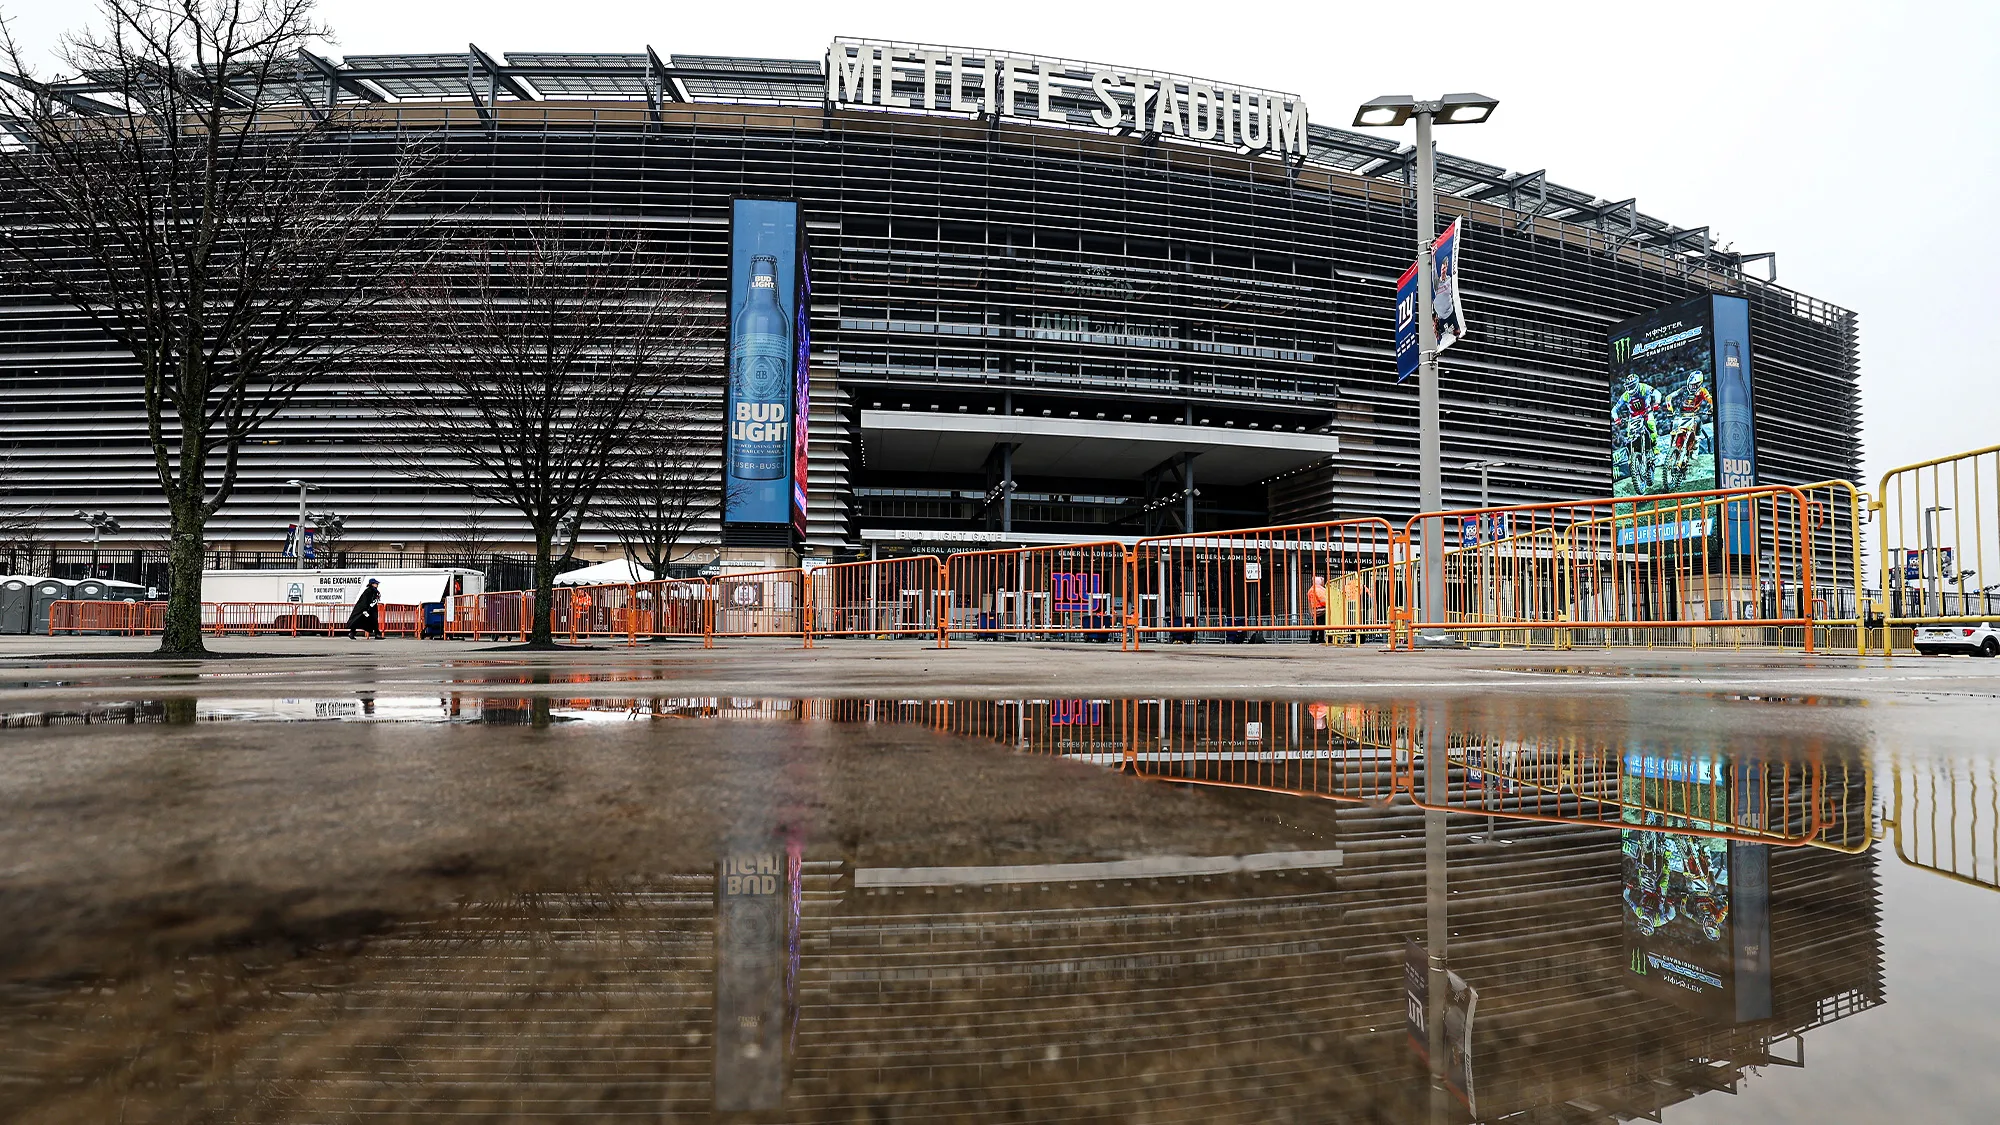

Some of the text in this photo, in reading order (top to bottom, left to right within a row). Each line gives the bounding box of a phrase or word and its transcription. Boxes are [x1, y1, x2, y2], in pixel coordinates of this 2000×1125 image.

[828, 43, 1309, 156] METLIFE STADIUM
[1398, 291, 1414, 333] ny
[1645, 321, 1683, 338] MONSTER
[1646, 340, 1687, 357] CHAMPIONSHIP
[737, 402, 785, 422] BUD
[731, 421, 788, 442] LIGHT
[1723, 457, 1751, 476] BUD
[900, 531, 1002, 542] BUD LIGHT GATE
[683, 552, 711, 562] EAST
[319, 577, 362, 585] BAG EXCHANGE
[1052, 572, 1100, 612] ny
